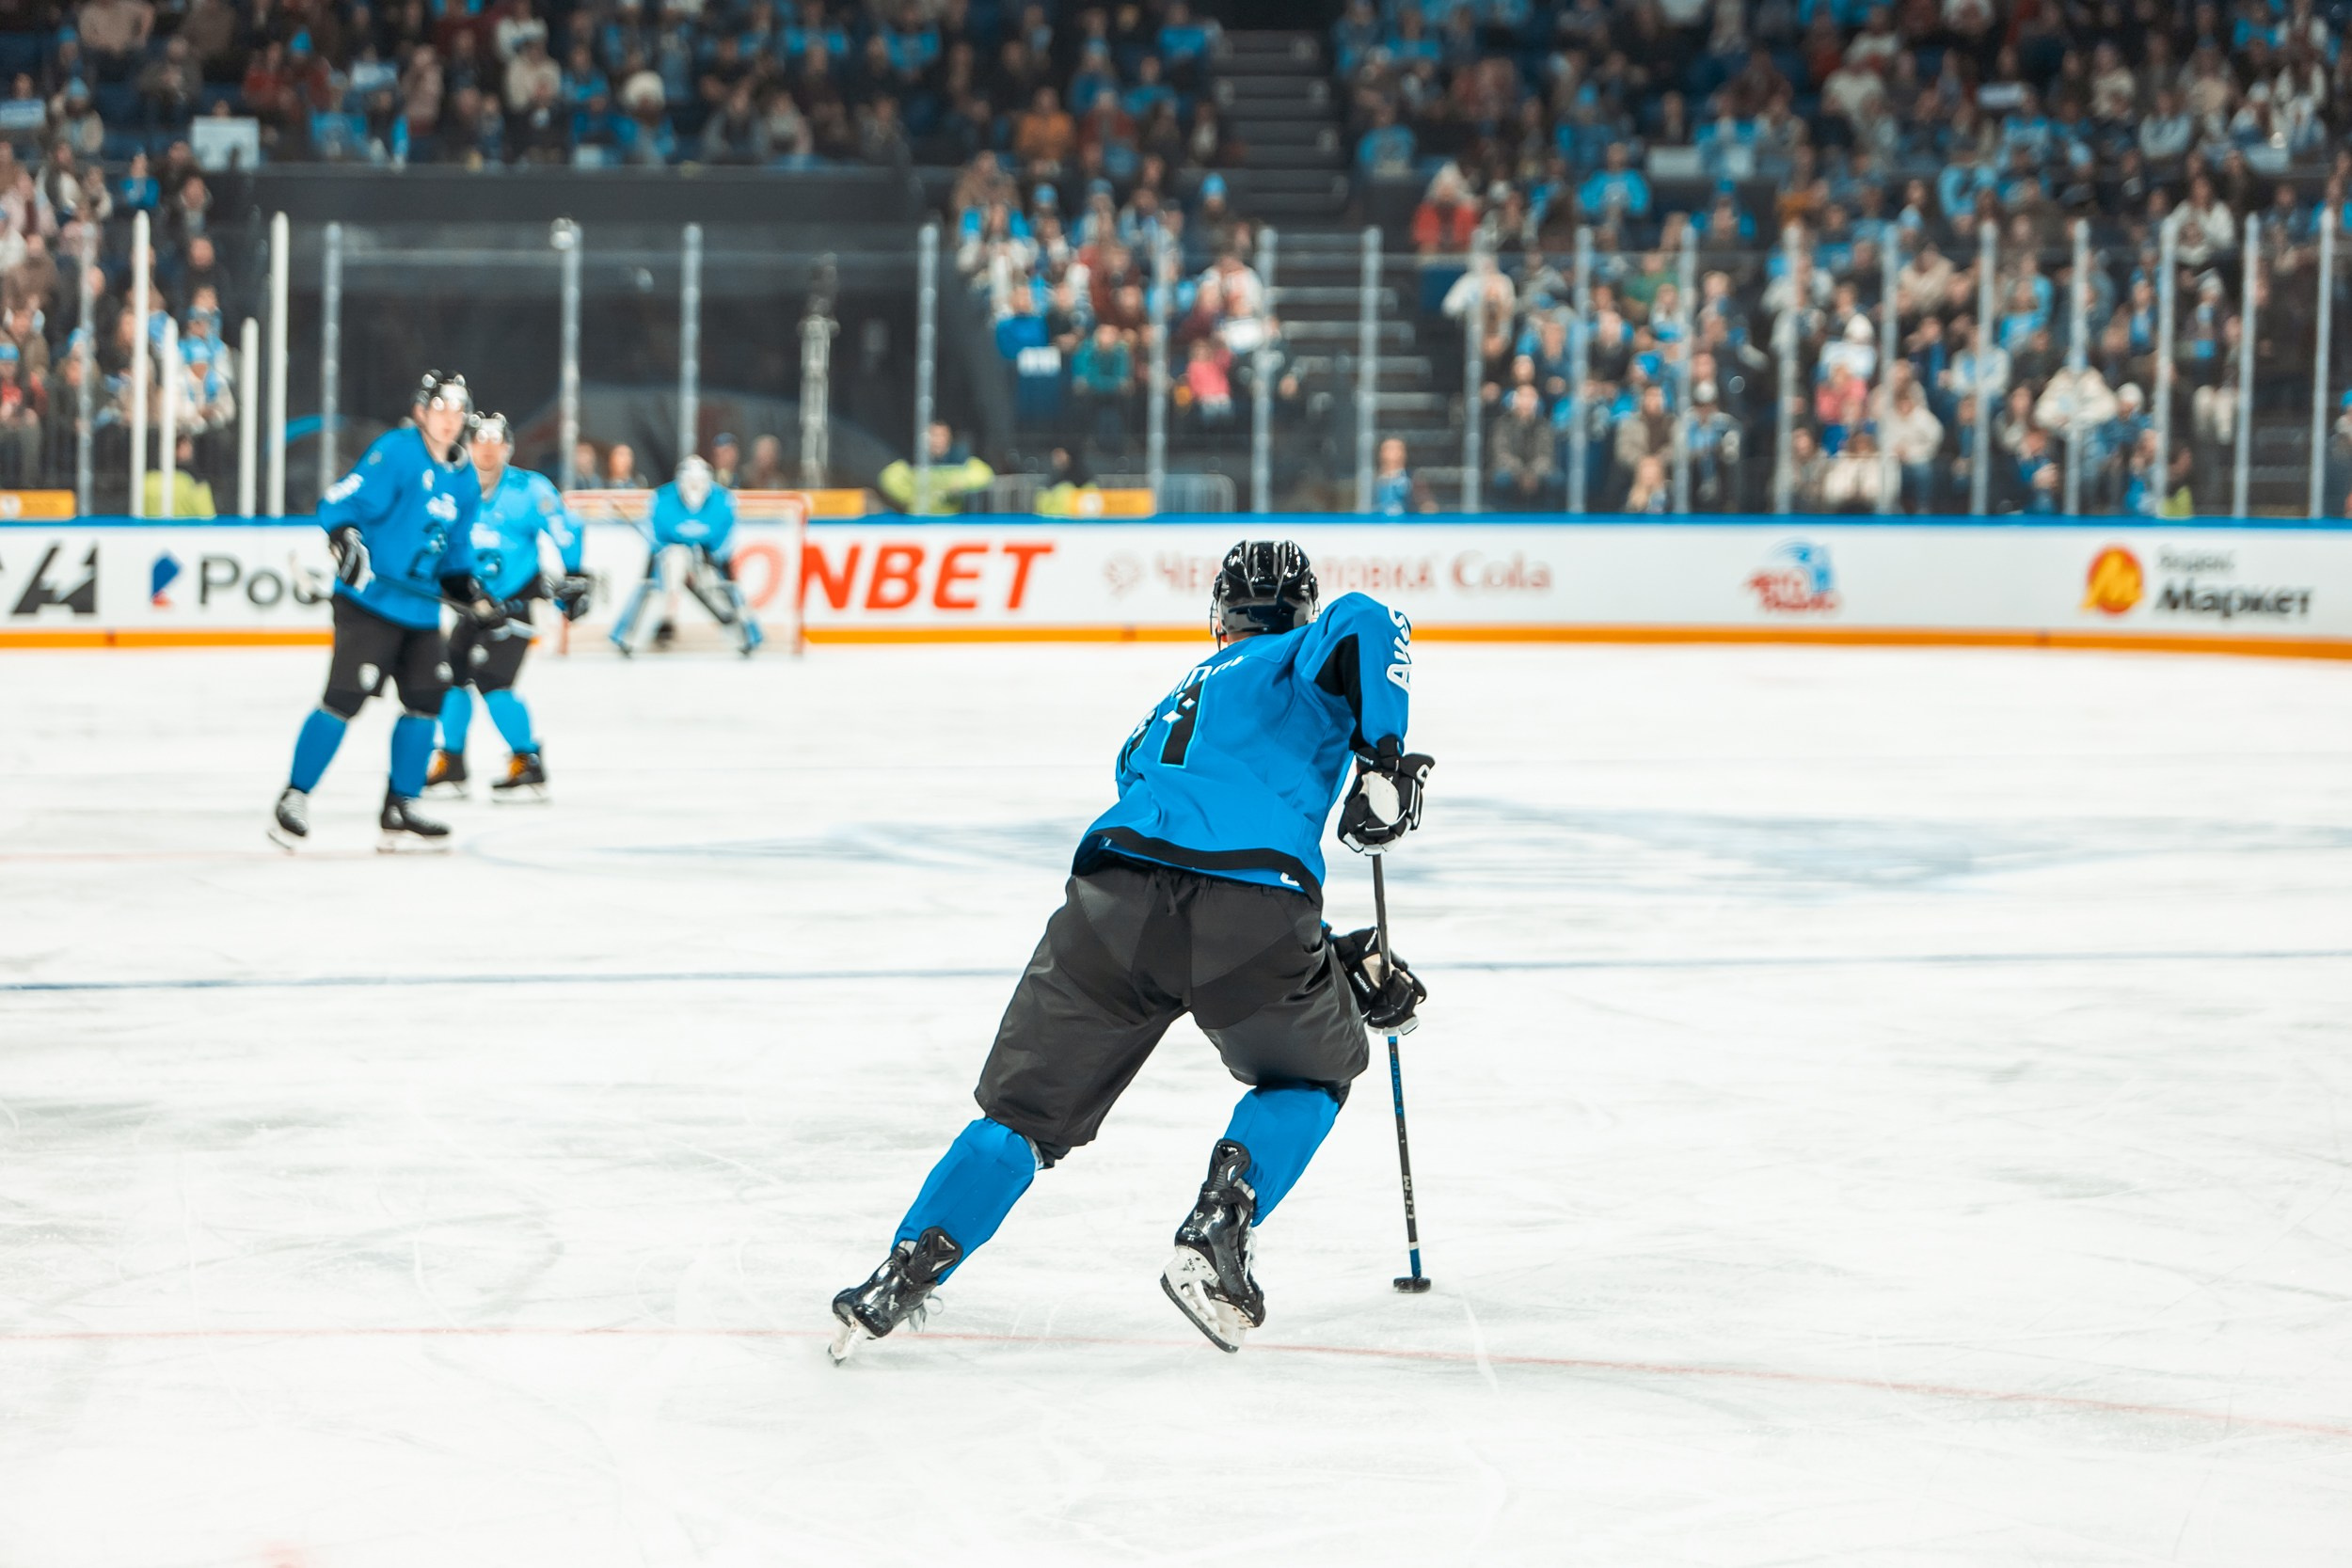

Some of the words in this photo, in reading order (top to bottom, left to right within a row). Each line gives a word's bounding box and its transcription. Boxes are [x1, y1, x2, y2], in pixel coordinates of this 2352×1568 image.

[730, 544, 1053, 610] ONBET
[2155, 580, 2314, 621] Маркет
[1403, 1174, 1414, 1219] CCM
